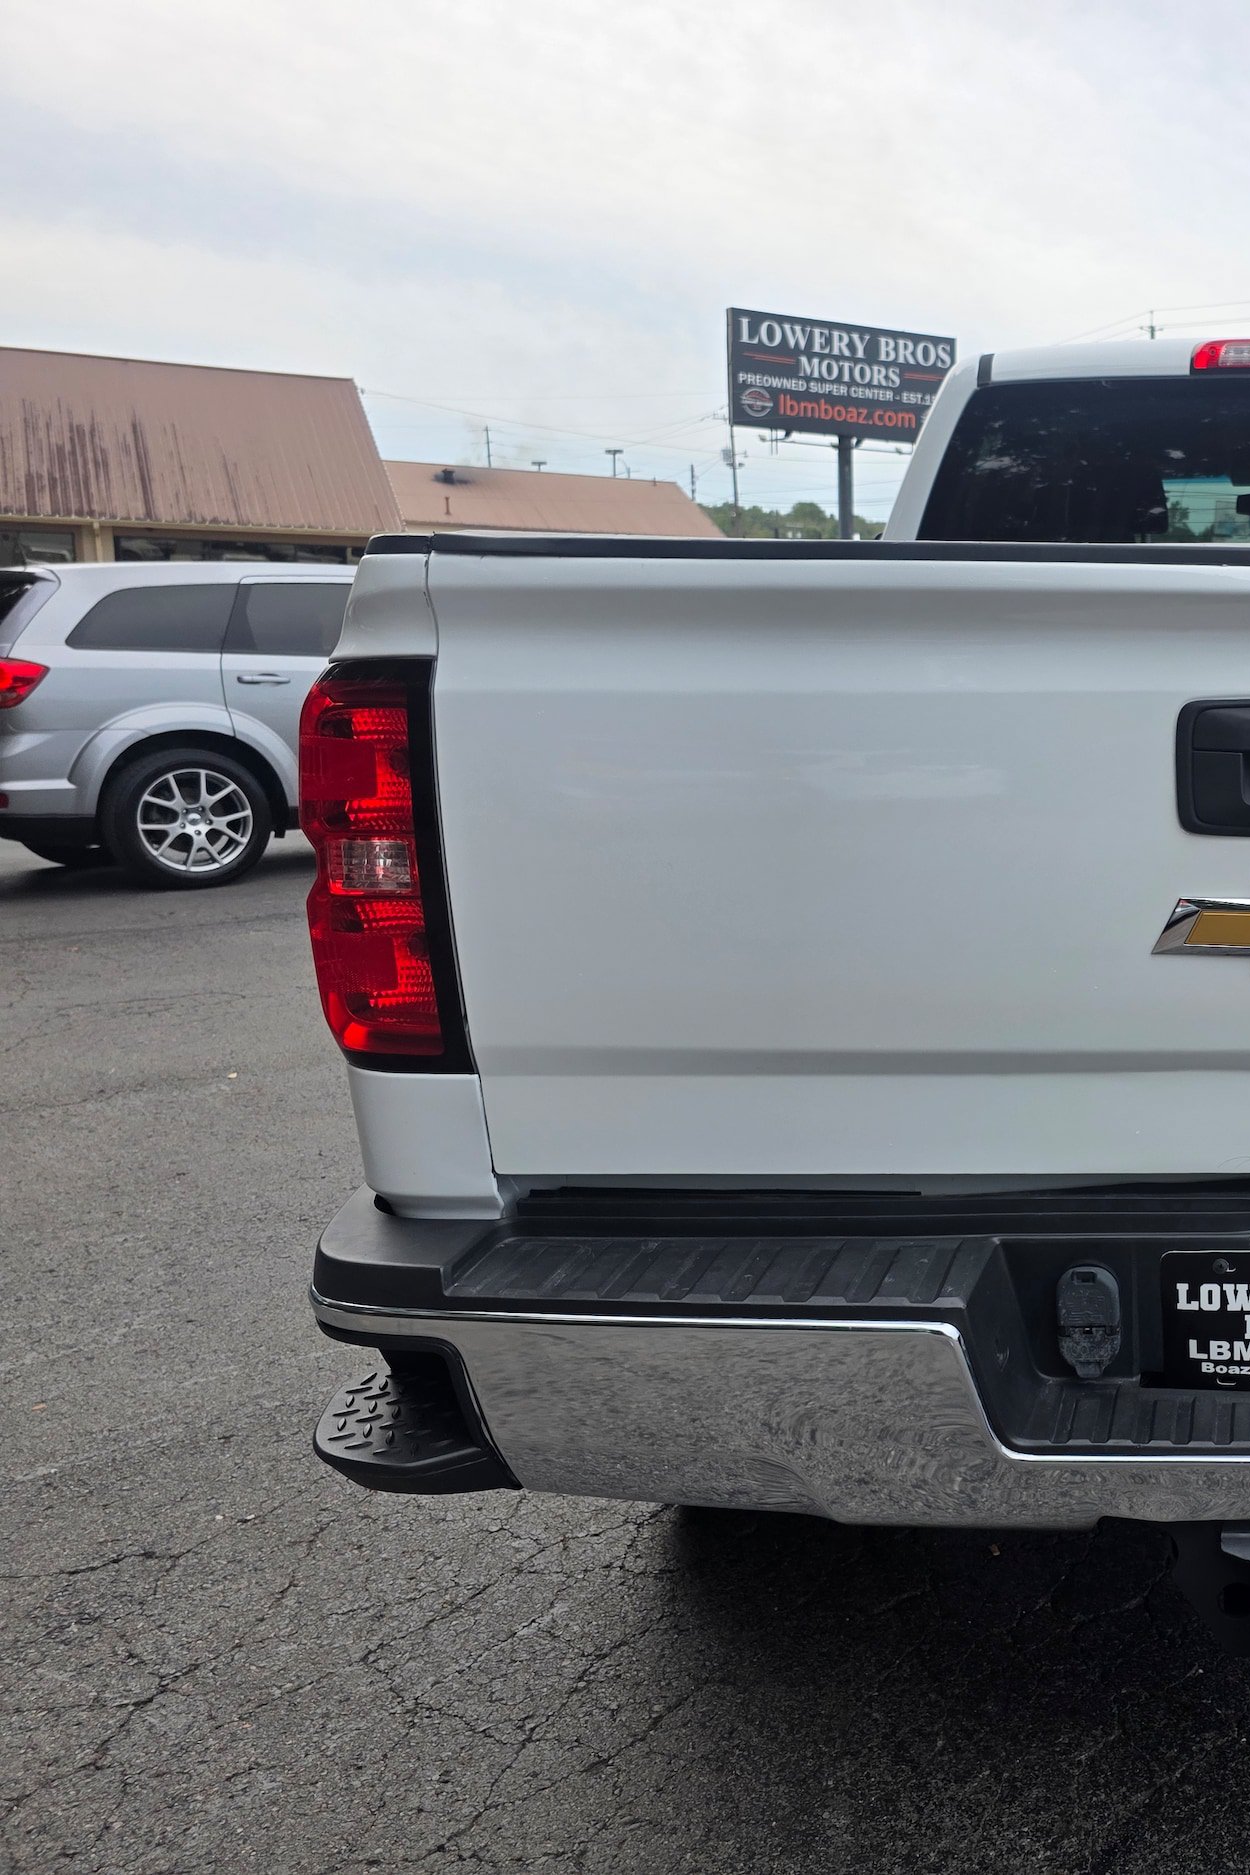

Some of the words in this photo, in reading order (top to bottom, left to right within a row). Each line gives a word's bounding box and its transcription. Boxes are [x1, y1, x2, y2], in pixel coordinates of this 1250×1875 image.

[739, 317, 871, 359] LOWERY
[879, 336, 951, 369] BROS
[738, 371, 807, 391] PREOWNED
[809, 381, 848, 396] SUPER
[851, 386, 894, 402] CENTER
[799, 356, 901, 388] MOTORS
[778, 393, 916, 429] lbmboaz.com
